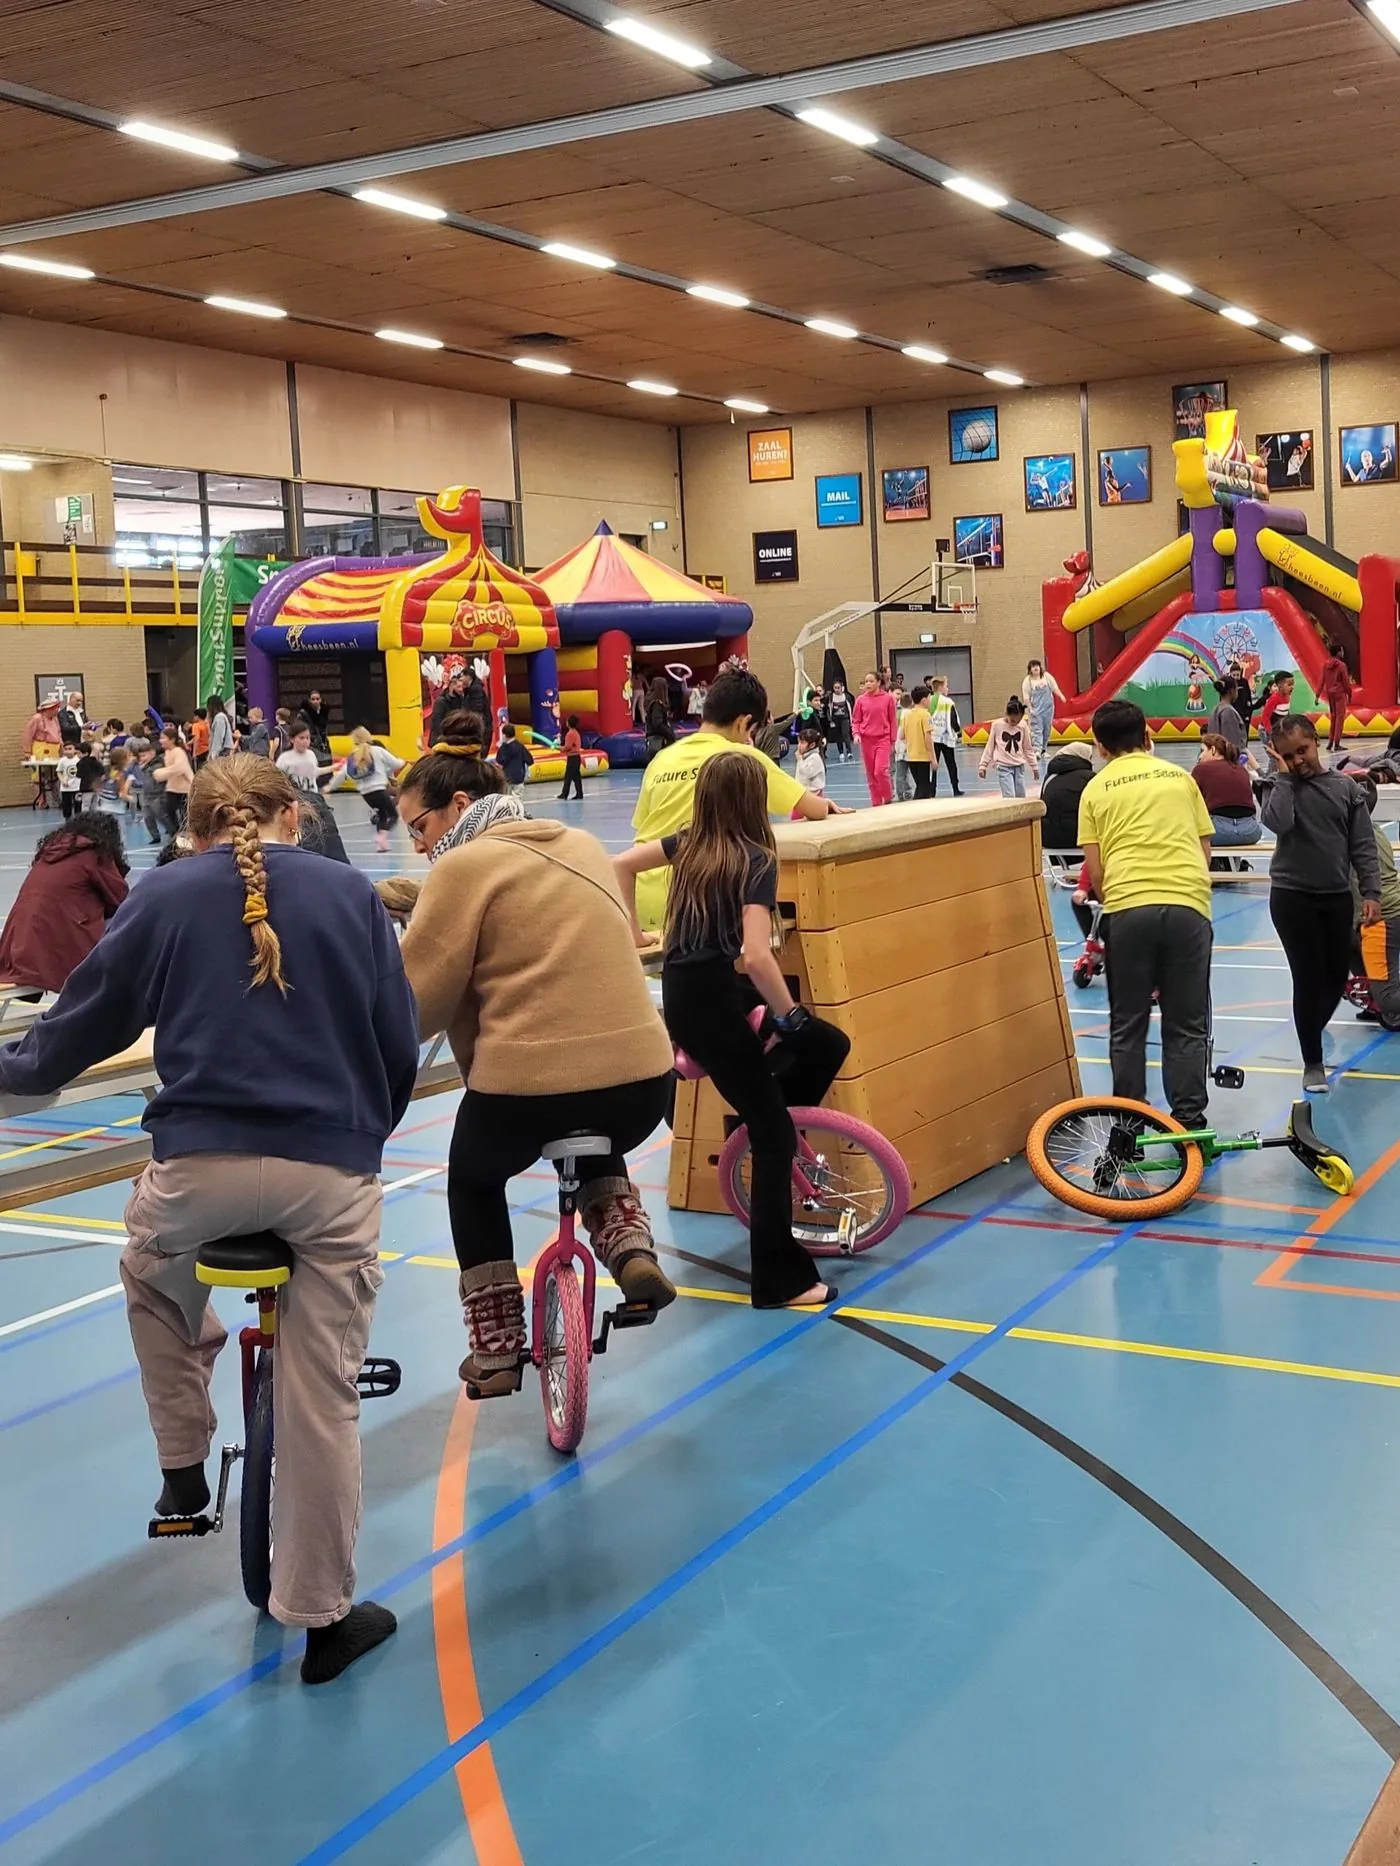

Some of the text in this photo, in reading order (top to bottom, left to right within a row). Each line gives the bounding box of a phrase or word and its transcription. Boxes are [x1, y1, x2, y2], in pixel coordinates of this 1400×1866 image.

[758, 440, 782, 451] ZAAL
[826, 491, 850, 502] MAIL
[758, 547, 792, 558] ONLINE
[462, 608, 513, 630] CIRCUS
[1105, 772, 1151, 791] Future
